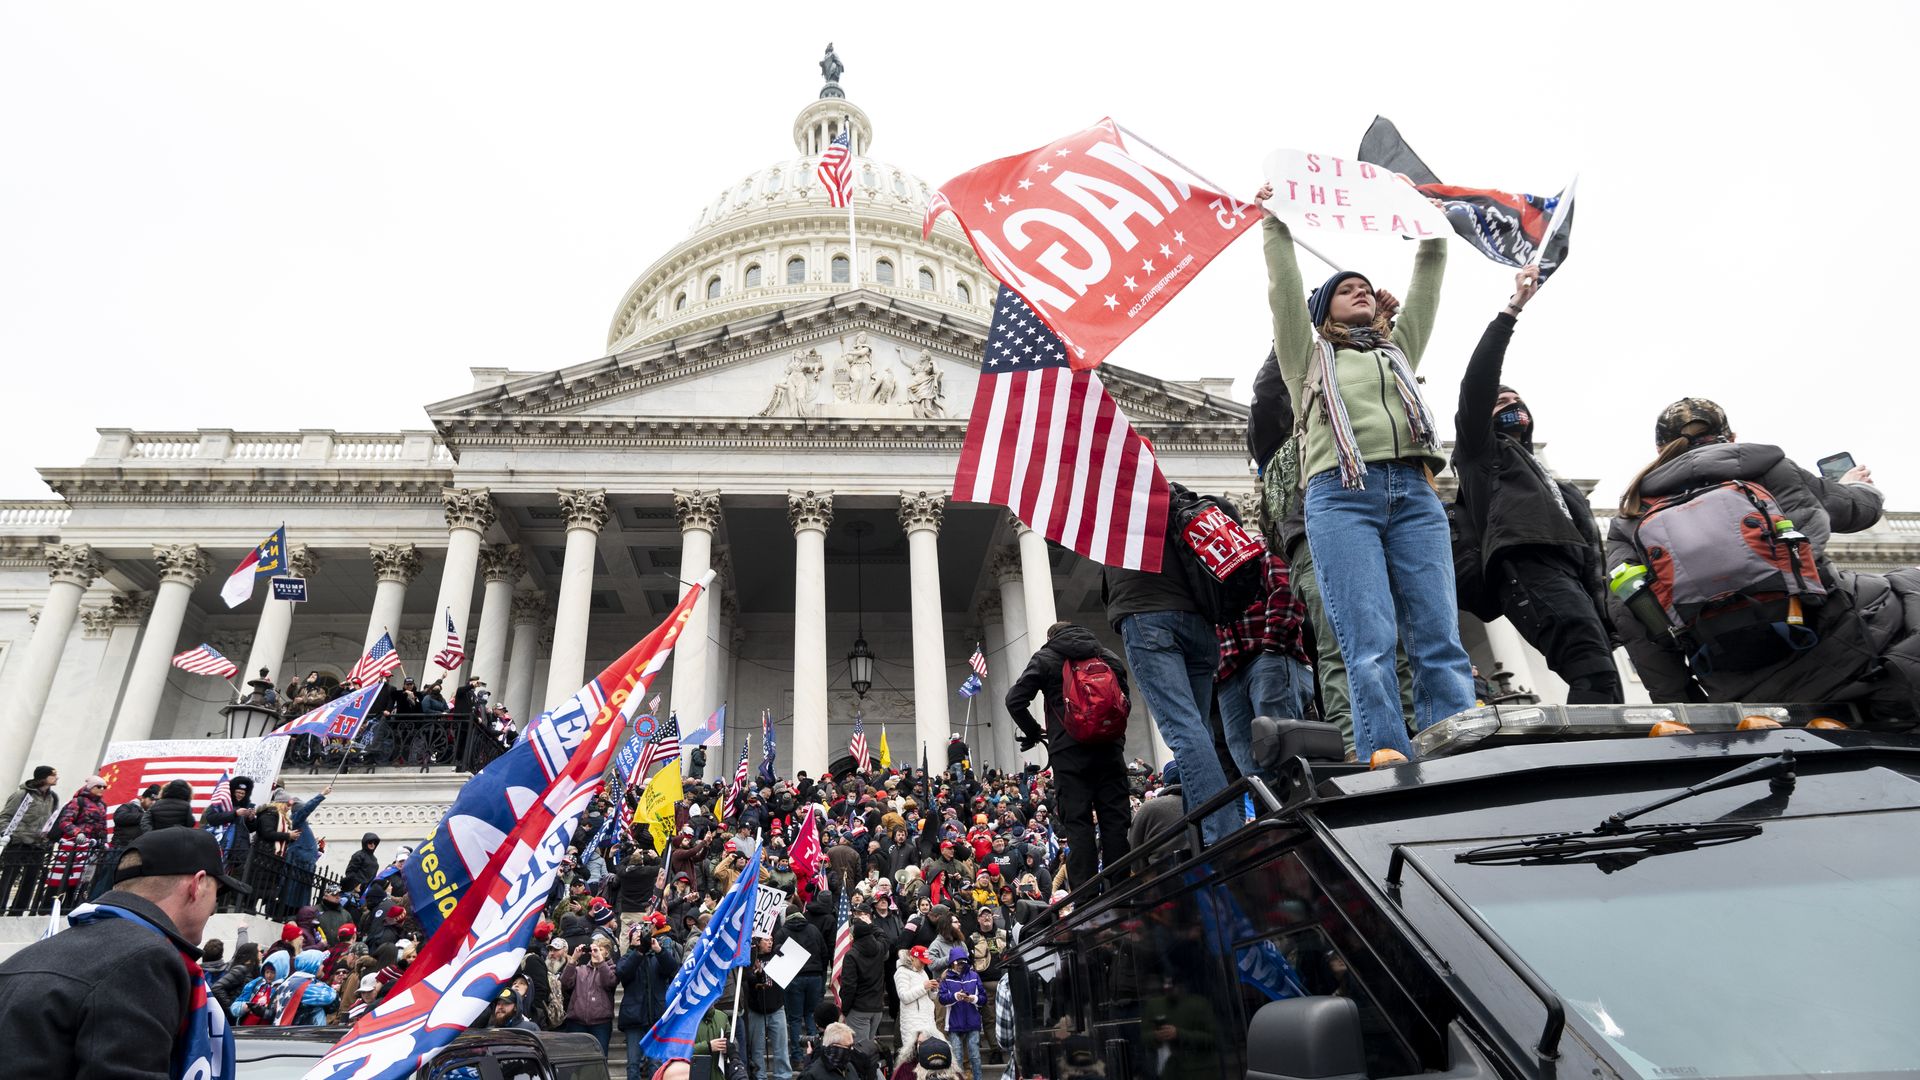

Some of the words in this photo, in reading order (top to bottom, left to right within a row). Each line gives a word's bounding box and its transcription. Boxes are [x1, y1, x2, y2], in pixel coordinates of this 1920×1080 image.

[1306, 153, 1378, 180] STO
[1286, 179, 1351, 207] THE
[1304, 212, 1433, 236] STEAL
